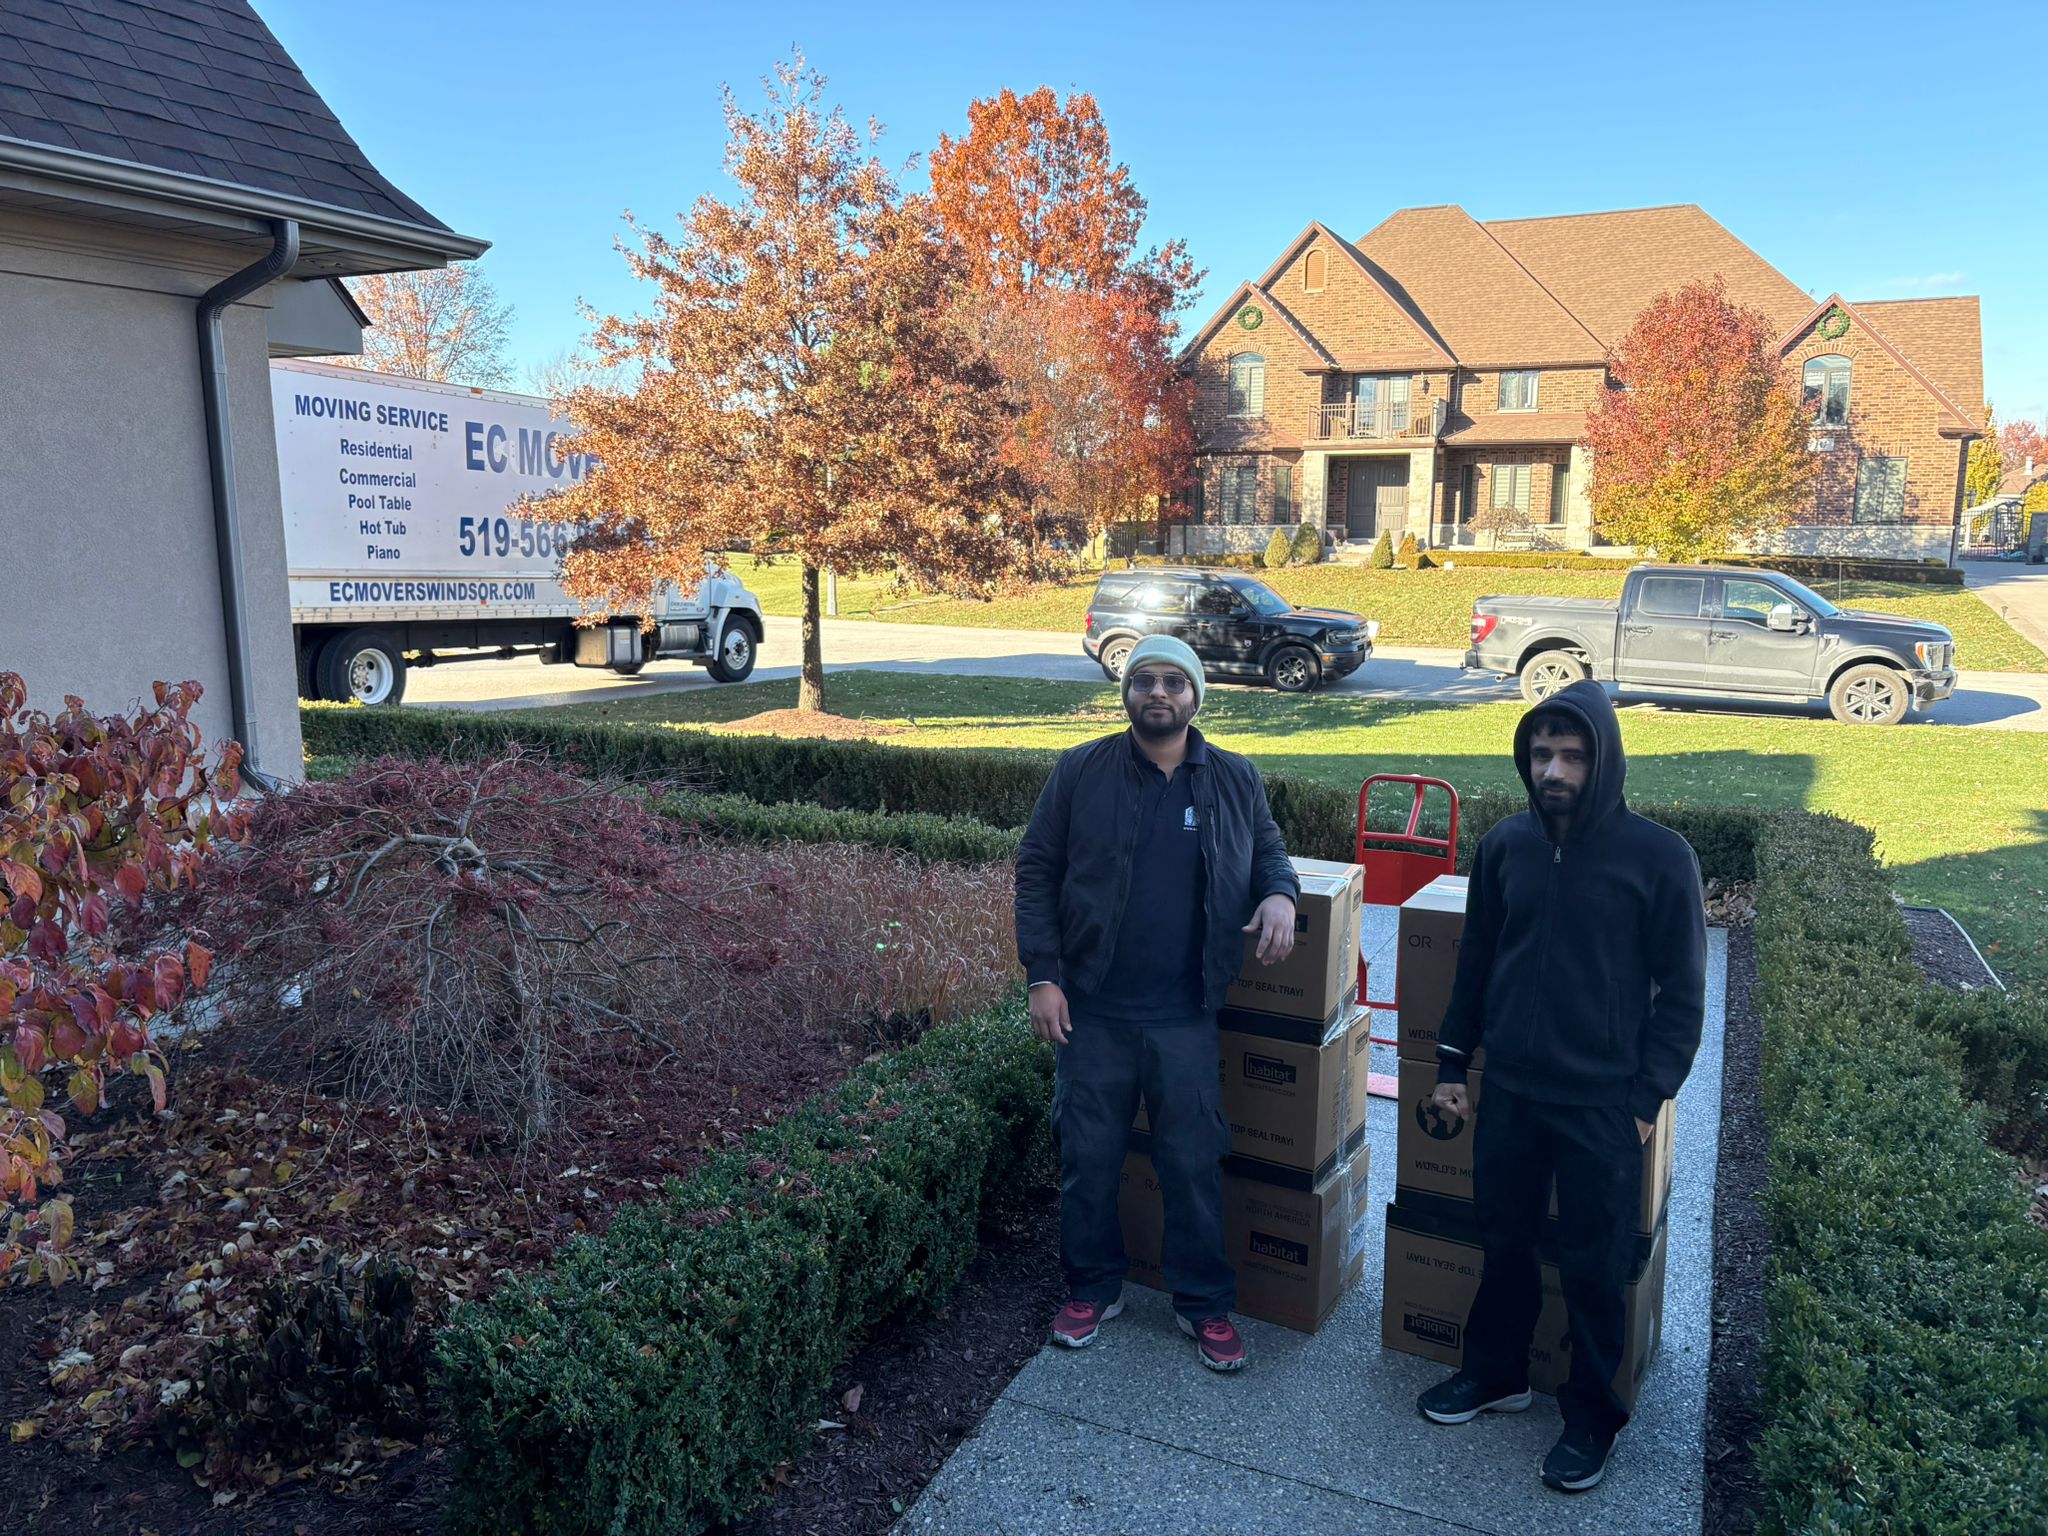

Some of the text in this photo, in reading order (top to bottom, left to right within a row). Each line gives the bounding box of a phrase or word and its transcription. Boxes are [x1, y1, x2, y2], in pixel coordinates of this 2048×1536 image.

[295, 394, 448, 433] MOVING SERVICE
[340, 438, 412, 460] Residential
[465, 421, 508, 474] EC
[339, 468, 416, 488] Commercial
[348, 494, 412, 511] Pool Table
[360, 520, 407, 535] Hot Tub
[459, 517, 590, 558] 519-566
[367, 545, 401, 559] Piano
[329, 582, 535, 602] ECMOVERSWINDSOR.COM
[1255, 981, 1278, 993] SEAL
[1249, 1062, 1291, 1081] habitat
[1247, 1127, 1269, 1140] SEAL
[1252, 1238, 1301, 1263] habitat
